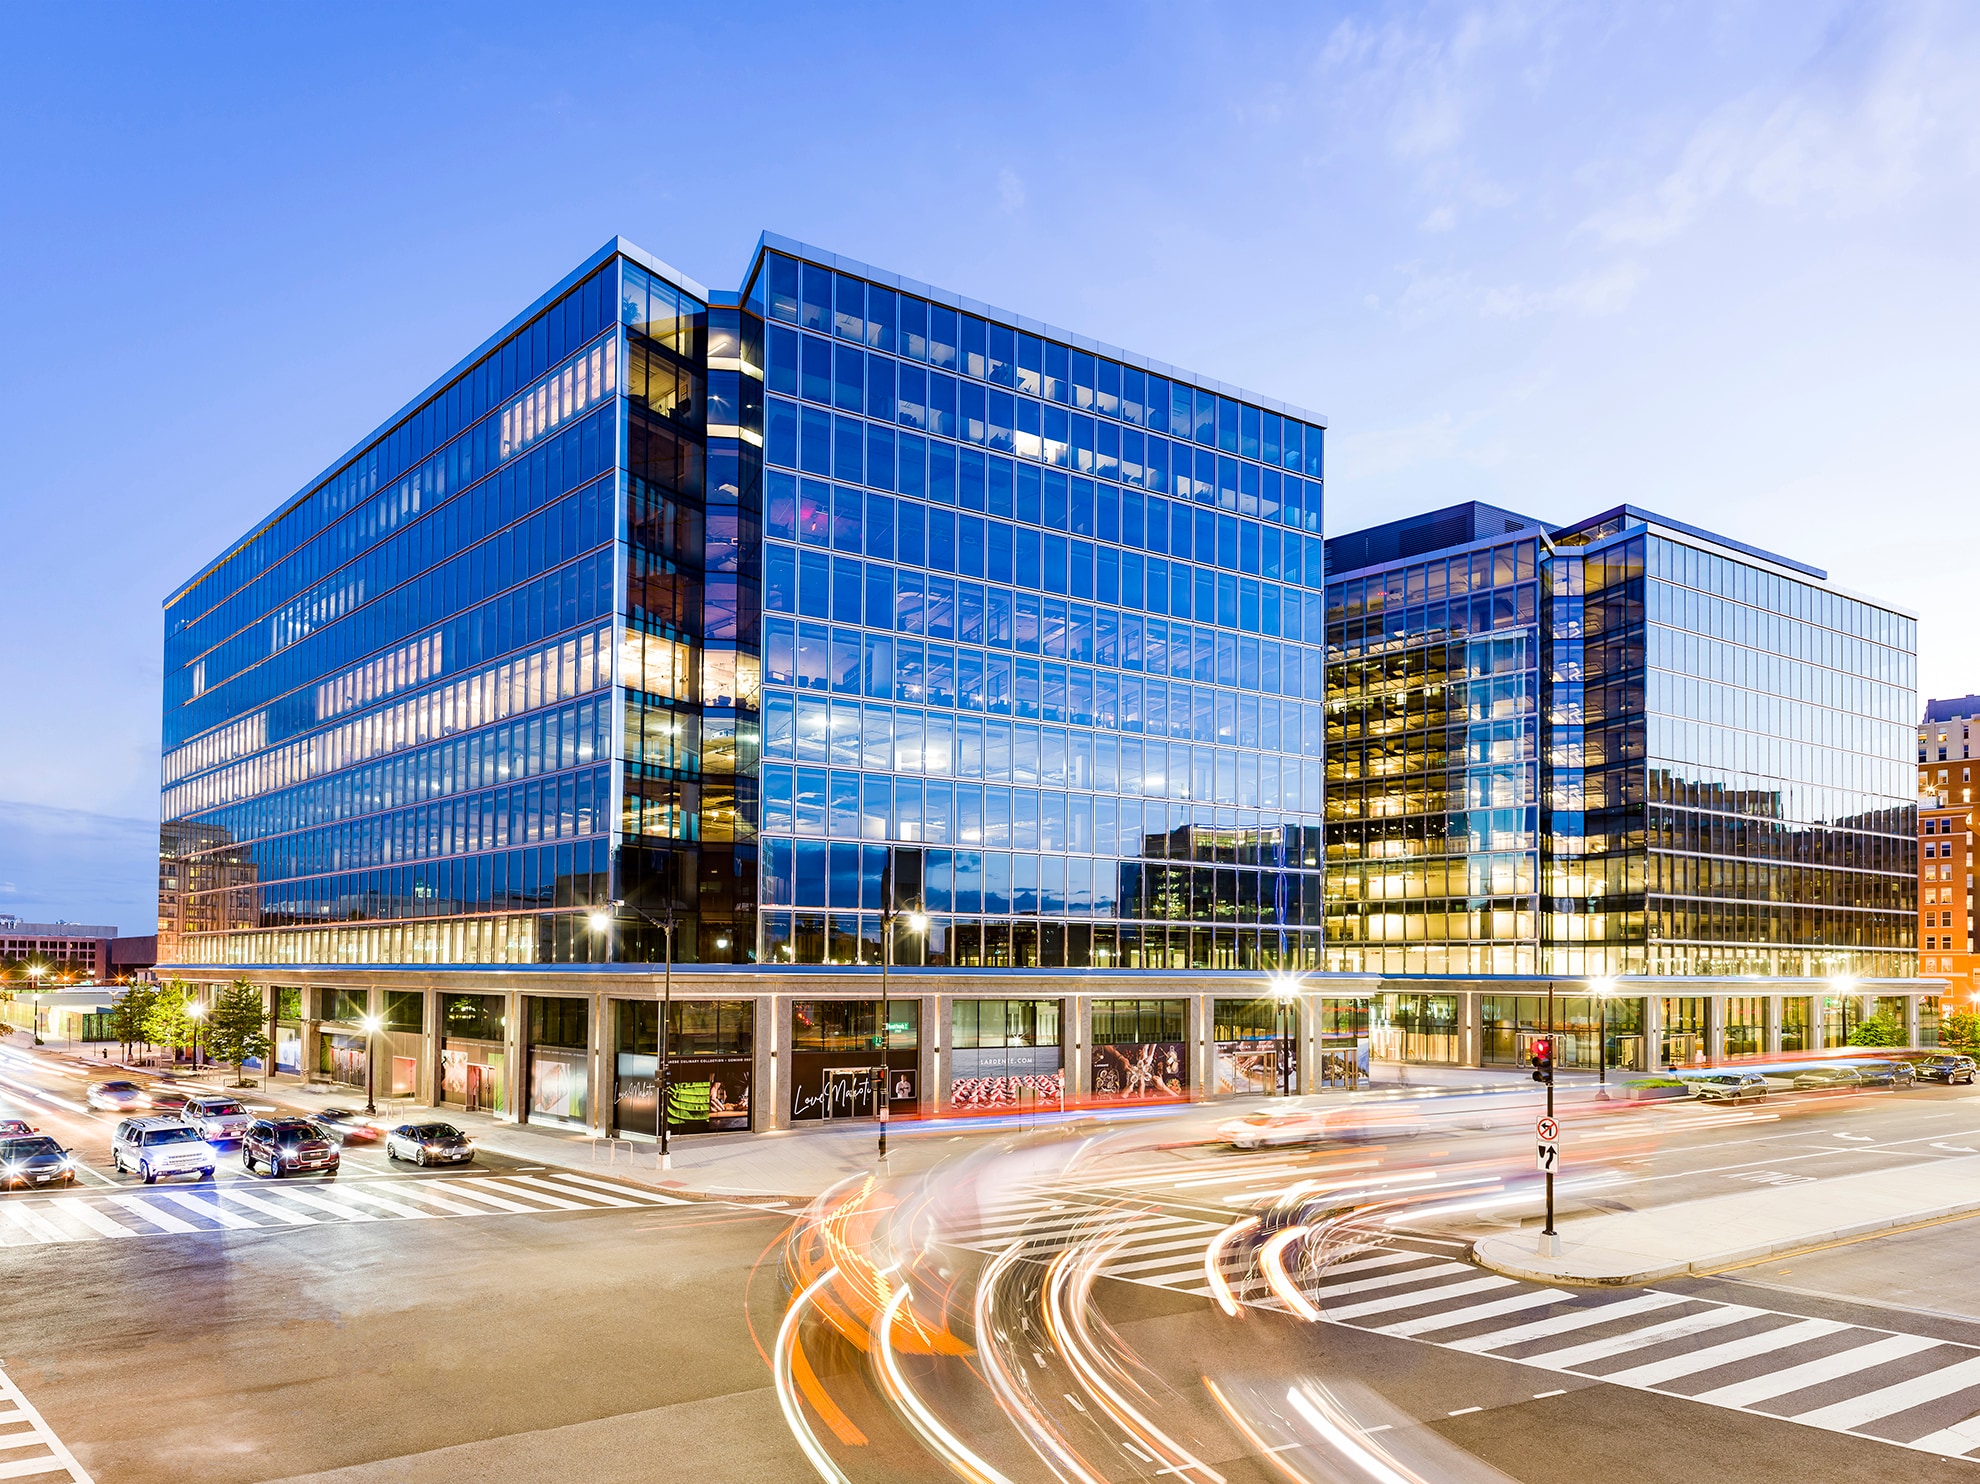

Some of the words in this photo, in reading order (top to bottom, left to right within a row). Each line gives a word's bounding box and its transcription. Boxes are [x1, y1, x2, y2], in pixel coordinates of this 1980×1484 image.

[613, 1081, 629, 1105] Love
[794, 1084, 824, 1115] Love
[824, 1077, 872, 1112] Makoto
